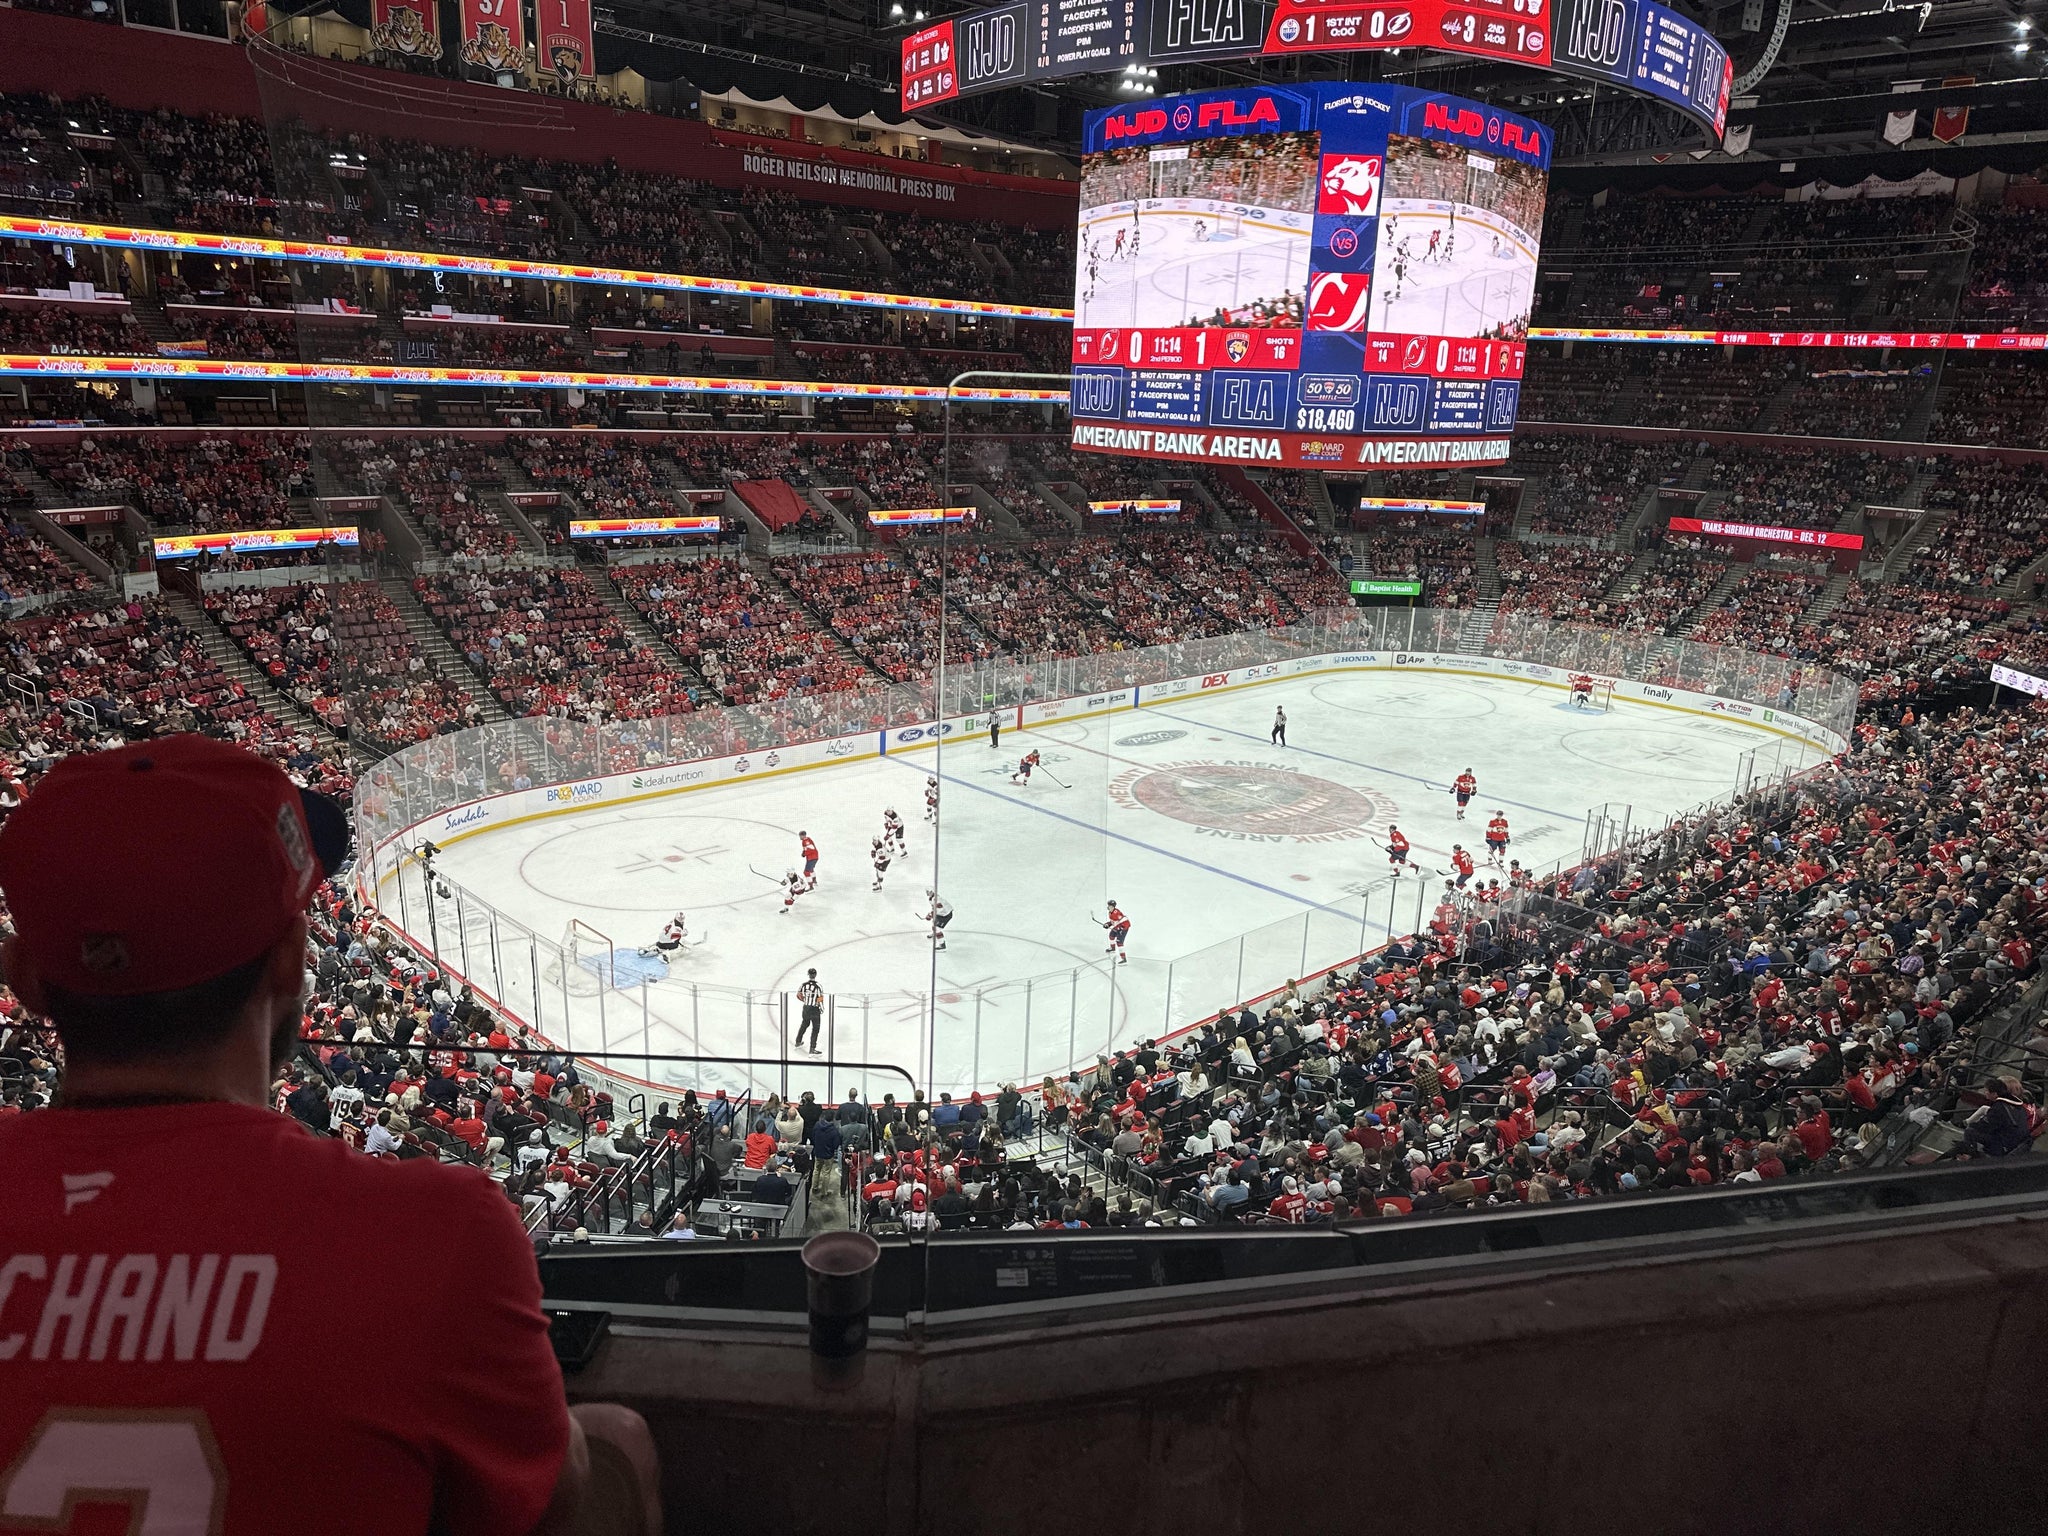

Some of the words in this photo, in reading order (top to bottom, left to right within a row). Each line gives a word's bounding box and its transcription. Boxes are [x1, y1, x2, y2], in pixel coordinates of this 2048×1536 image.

[1125, 2, 1134, 13] 52
[1063, 8, 1100, 22] FACEOFF
[1101, 8, 1108, 16] %
[1124, 16, 1133, 26] 13
[1326, 18, 1344, 28] 1ST
[1345, 16, 1362, 26] INT
[1058, 22, 1094, 36] FACEOFFS
[1095, 20, 1112, 29] WON
[1168, 0, 1244, 47] FLA
[1306, 15, 1316, 42] 1
[1370, 11, 1386, 39] 0
[1463, 15, 1476, 42] 3
[1487, 24, 1505, 34] 2ND
[1041, 30, 1048, 41] 12
[1125, 30, 1130, 40] 0
[1330, 27, 1356, 38] 0:00
[1517, 25, 1526, 52] 1
[1568, 0, 1626, 66] NJD
[551, 37, 581, 49] FLORIDA
[968, 14, 1015, 80] NJD
[1076, 36, 1092, 46] PIM
[934, 42, 940, 64] 0
[1042, 44, 1046, 54] 0
[1057, 52, 1076, 62] POWER
[1076, 50, 1090, 60] PLAY
[1090, 47, 1110, 58] GOALS
[1120, 42, 1134, 55] 0/0
[912, 52, 916, 72] 1
[1038, 56, 1050, 68] 0/0
[937, 72, 942, 93] 1
[1698, 44, 1722, 112] FLA
[914, 80, 919, 100] 3
[1324, 97, 1352, 110] FLORIDA
[1364, 97, 1391, 112] HOCKEY
[1105, 110, 1168, 140] NJD
[1177, 114, 1188, 124] VS
[1198, 98, 1280, 128] FLA
[1424, 102, 1484, 138] NJD
[1490, 124, 1498, 136] VS
[1502, 122, 1540, 156] FLA
[744, 154, 785, 178] ROGER
[787, 160, 837, 184] NEILSON
[840, 168, 898, 194] MEMORIAL
[900, 178, 933, 199] PRESS
[935, 184, 956, 202] BOX
[38, 220, 84, 238] Surfside
[130, 230, 175, 246] Surfside
[220, 238, 263, 252] Surfside
[306, 245, 345, 260] Surfside
[384, 252, 422, 266] Surfside
[458, 257, 493, 271] Surfside
[526, 263, 560, 277] Surfside
[1154, 336, 1181, 354] 11:14
[1266, 338, 1294, 346] SHOTS
[1824, 334, 1830, 346] 0
[1844, 334, 1868, 346] 11:14
[1909, 335, 1915, 346] 1
[1080, 343, 1088, 356] 14
[1130, 331, 1142, 364] 0
[1196, 331, 1206, 365] 1
[1274, 346, 1286, 360] 16
[1378, 349, 1388, 363] 14
[1436, 340, 1449, 373] 0
[1458, 346, 1476, 364] 11:14
[1484, 344, 1492, 375] 1
[38, 355, 84, 373] Surfside
[131, 360, 176, 375] Surfside
[222, 362, 266, 376] Surfside
[311, 366, 351, 380] Surfside
[392, 368, 430, 382] Surfside
[468, 370, 503, 384] Surfside
[538, 373, 572, 385] Surfside
[1158, 372, 1192, 380] ATTEMPTS
[1080, 373, 1115, 412] NJD
[1146, 382, 1176, 390] FACEOFF
[1177, 382, 1183, 390] %
[1306, 383, 1322, 394] 50
[1336, 384, 1352, 394] 50
[1138, 391, 1172, 400] FACEOFFS
[1173, 392, 1190, 400] WON
[1222, 378, 1274, 422] FLA
[1374, 384, 1420, 424] NJD
[1492, 388, 1514, 424] FLA
[1156, 412, 1170, 420] PLAY
[1296, 408, 1356, 432] $18,460
[1072, 424, 1154, 452] AMERANT
[1154, 432, 1207, 456] BANK
[1208, 436, 1283, 461] ARENA
[1358, 440, 1452, 464] AMERANT
[1451, 440, 1484, 462] BANK
[1484, 440, 1510, 460] ARENA
[365, 500, 378, 510] 116
[104, 511, 119, 521] 115
[626, 520, 660, 532] Surfside
[1702, 521, 1754, 536] TRANS-SIBERIAN
[1754, 526, 1793, 541] ORCHESTRA
[1800, 532, 1816, 544] DEC.
[1817, 534, 1826, 545] 12
[229, 534, 273, 548] Surfside
[1370, 584, 1392, 593] Baptist
[1392, 584, 1413, 593] Health
[1202, 672, 1230, 689] DEX
[1643, 686, 1673, 702] finally
[1038, 702, 1065, 712] AMERANT
[1044, 710, 1058, 718] BANK
[1729, 703, 1752, 714] ACTION
[1774, 714, 1793, 728] Baptist
[900, 731, 924, 741] Ford
[1155, 760, 1215, 770] BANK
[1224, 759, 1300, 772] ARENA
[547, 782, 602, 802] BROWARD
[1109, 768, 1147, 810] AMERANT
[573, 793, 602, 804] COUNTY
[445, 806, 489, 830] Sandals
[334, 1099, 352, 1118] 19
[0, 1253, 278, 1362] CHAND
